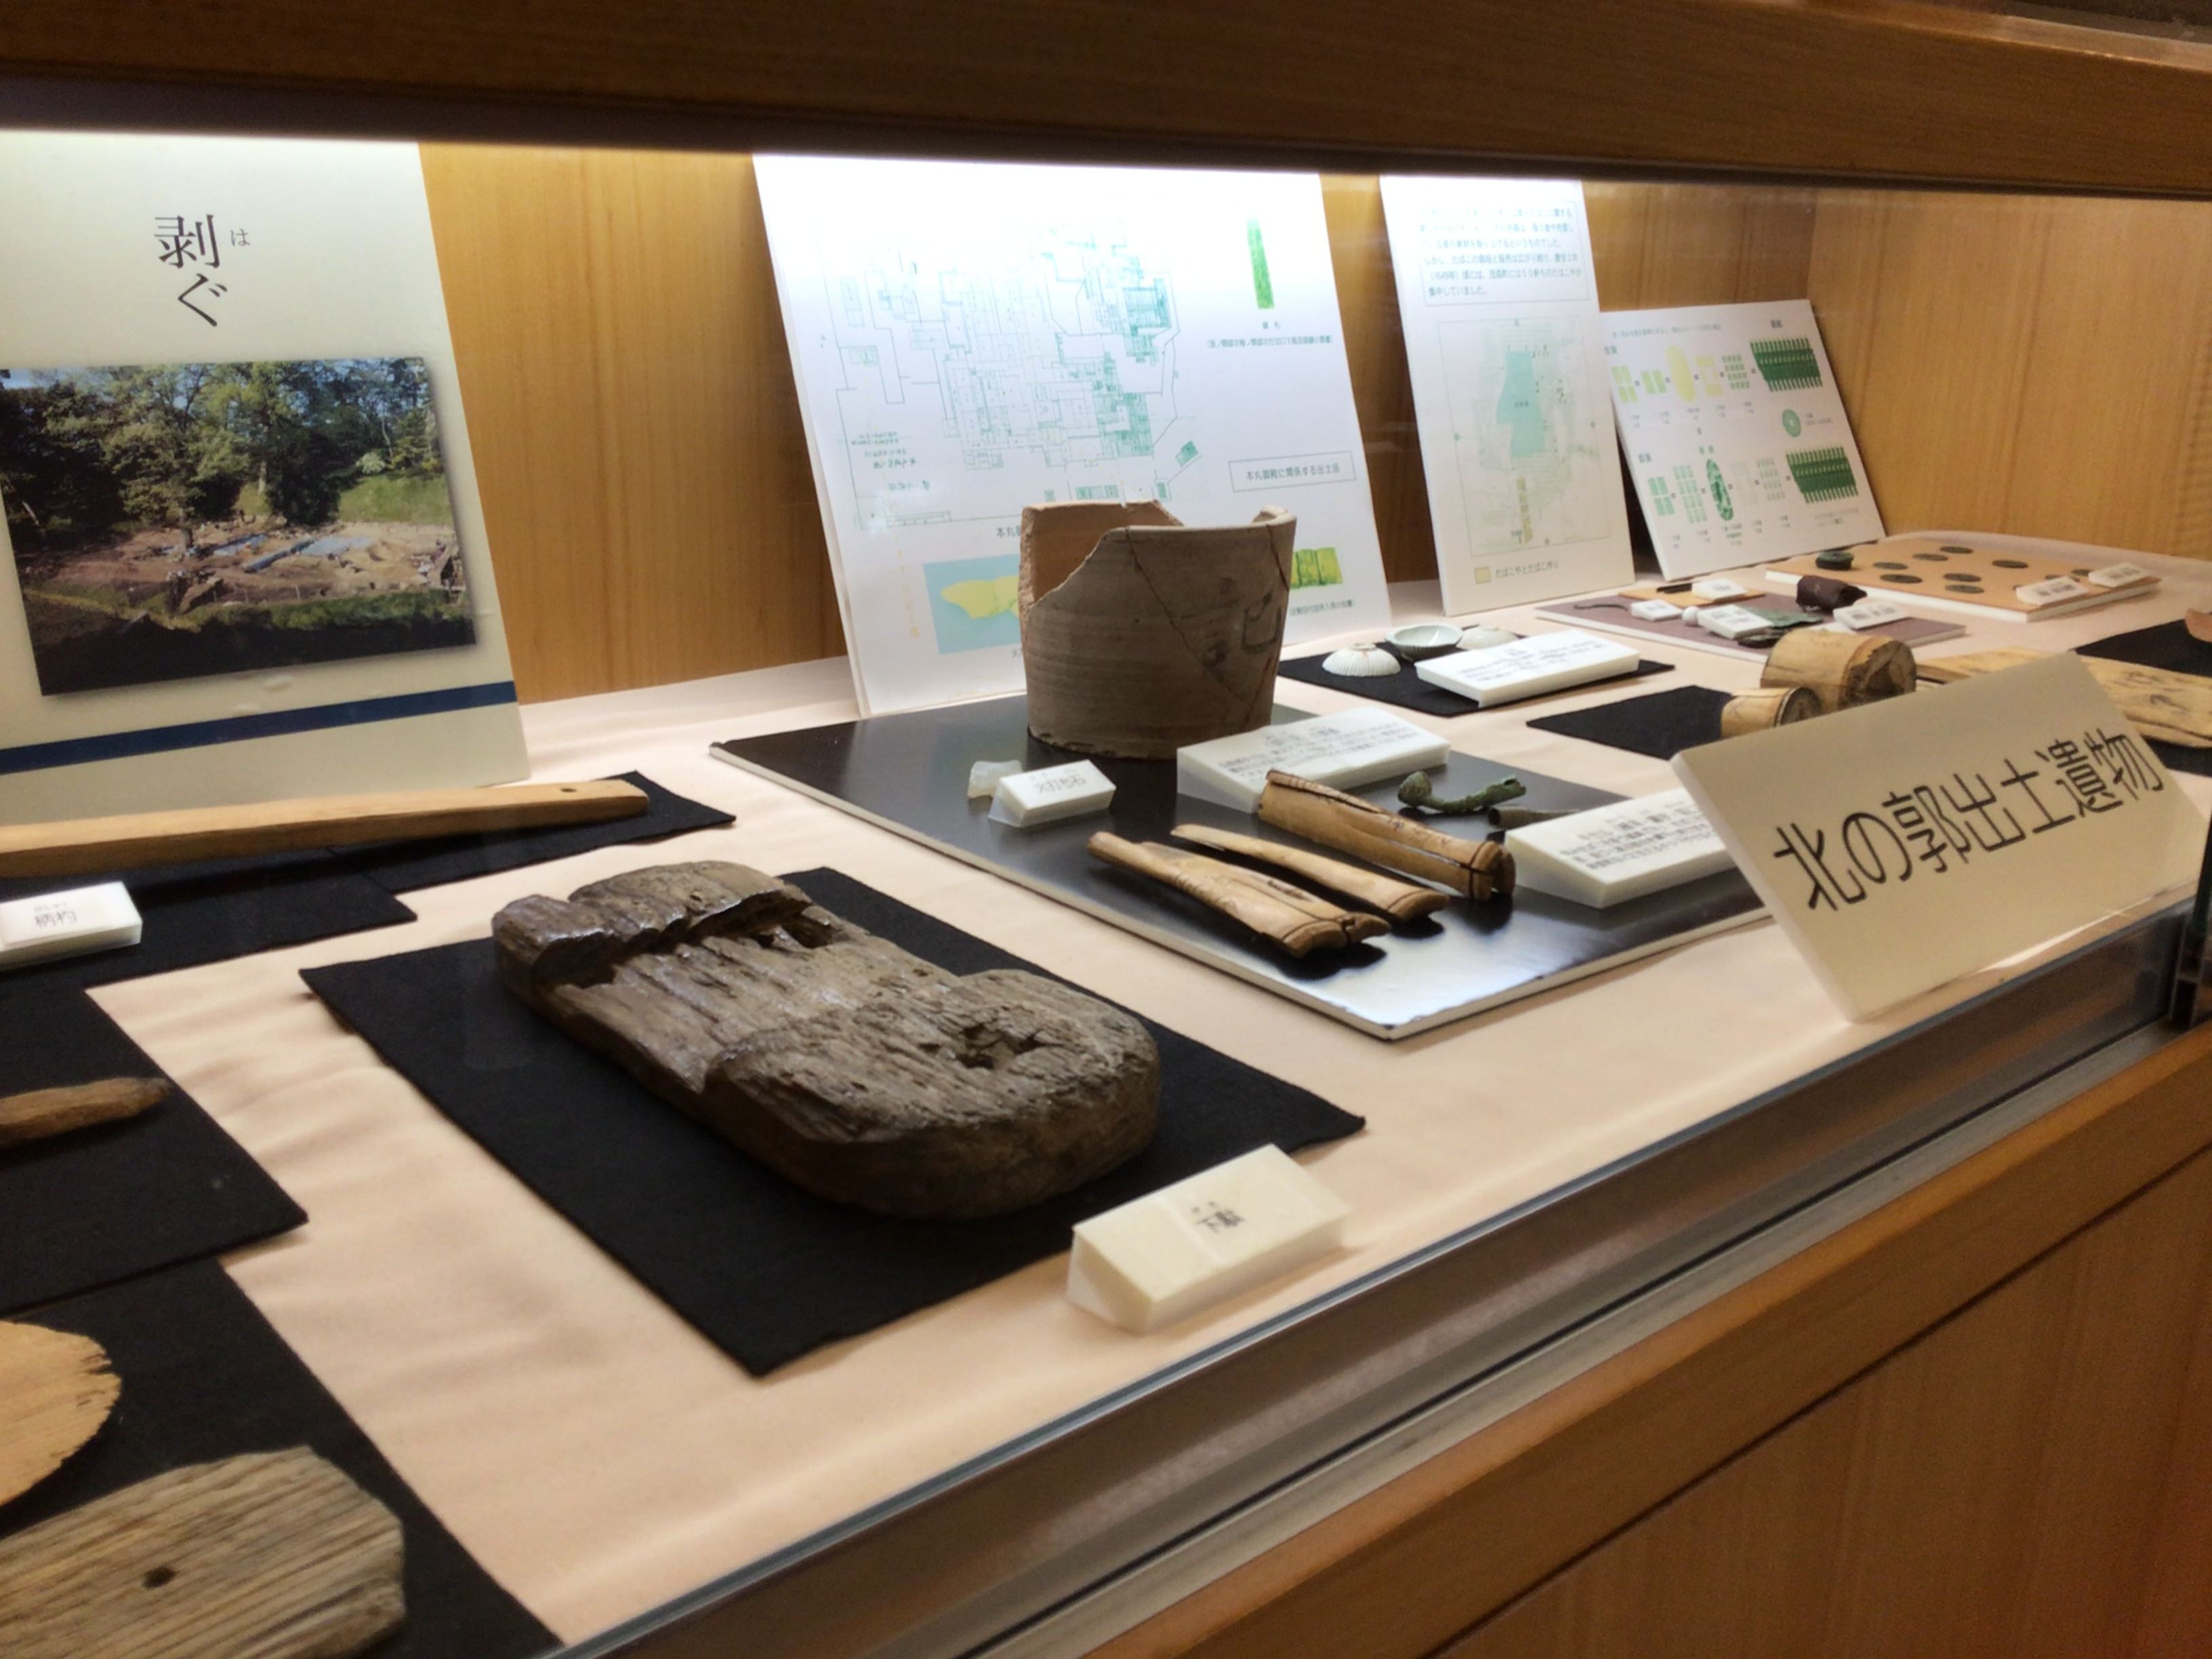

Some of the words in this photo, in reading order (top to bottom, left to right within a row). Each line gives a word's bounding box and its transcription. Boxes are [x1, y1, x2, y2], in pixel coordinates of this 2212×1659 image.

[154, 213, 228, 327] 剥ぐ
[230, 228, 250, 247] は
[1774, 729, 2164, 911] 北の郭出土遺物
